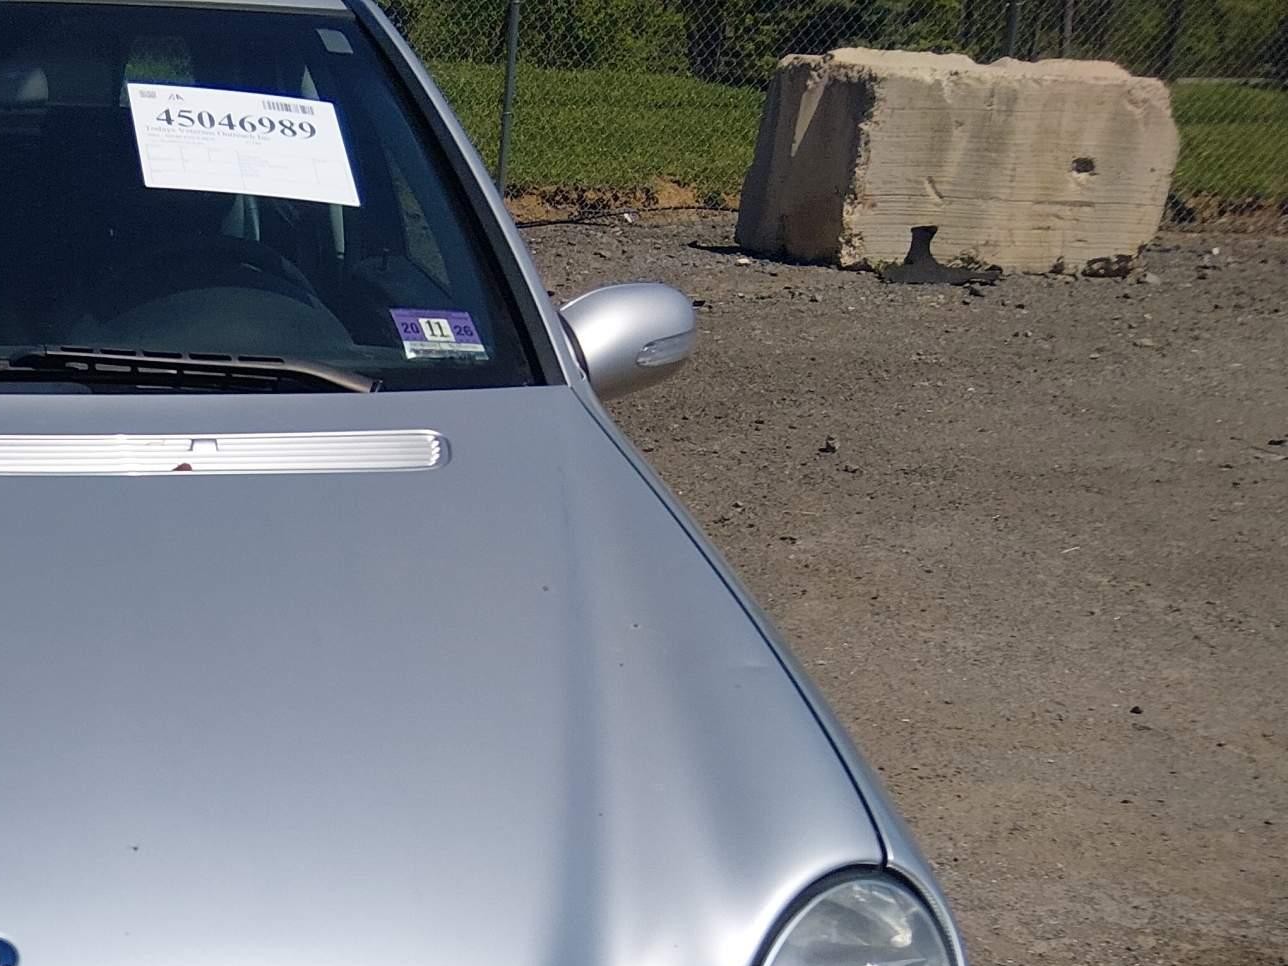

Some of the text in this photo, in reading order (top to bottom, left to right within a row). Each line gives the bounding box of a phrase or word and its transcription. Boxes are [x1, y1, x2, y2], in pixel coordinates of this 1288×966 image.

[156, 108, 317, 140] 45046989
[401, 320, 474, 338] 20 11 26
